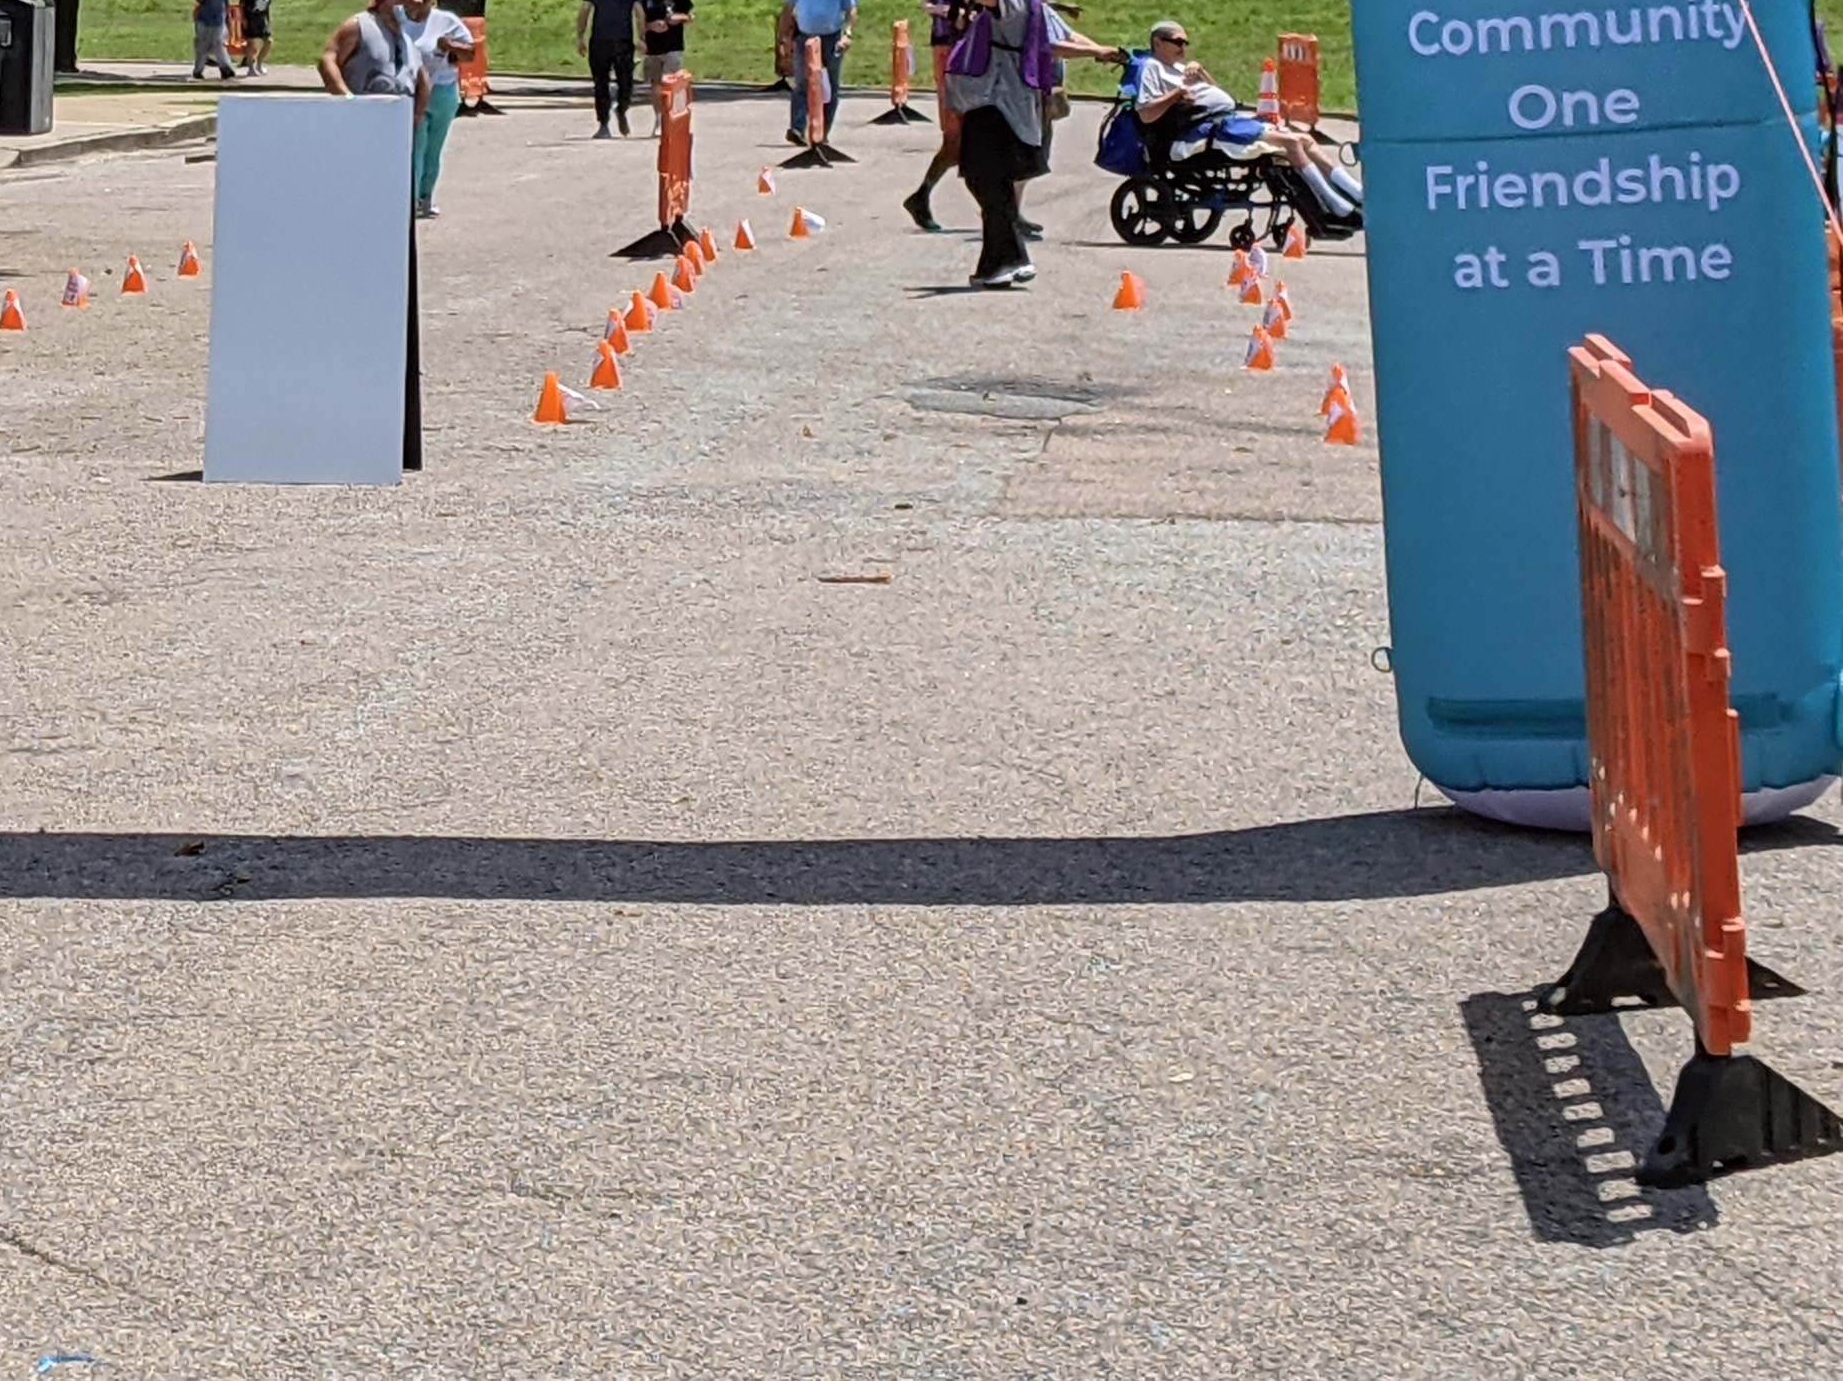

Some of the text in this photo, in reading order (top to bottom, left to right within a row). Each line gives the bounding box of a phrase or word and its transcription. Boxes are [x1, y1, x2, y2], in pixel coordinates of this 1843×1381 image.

[1508, 83, 1641, 131] One
[1425, 151, 1741, 211] Friendship
[1453, 235, 1733, 289] at a Time
